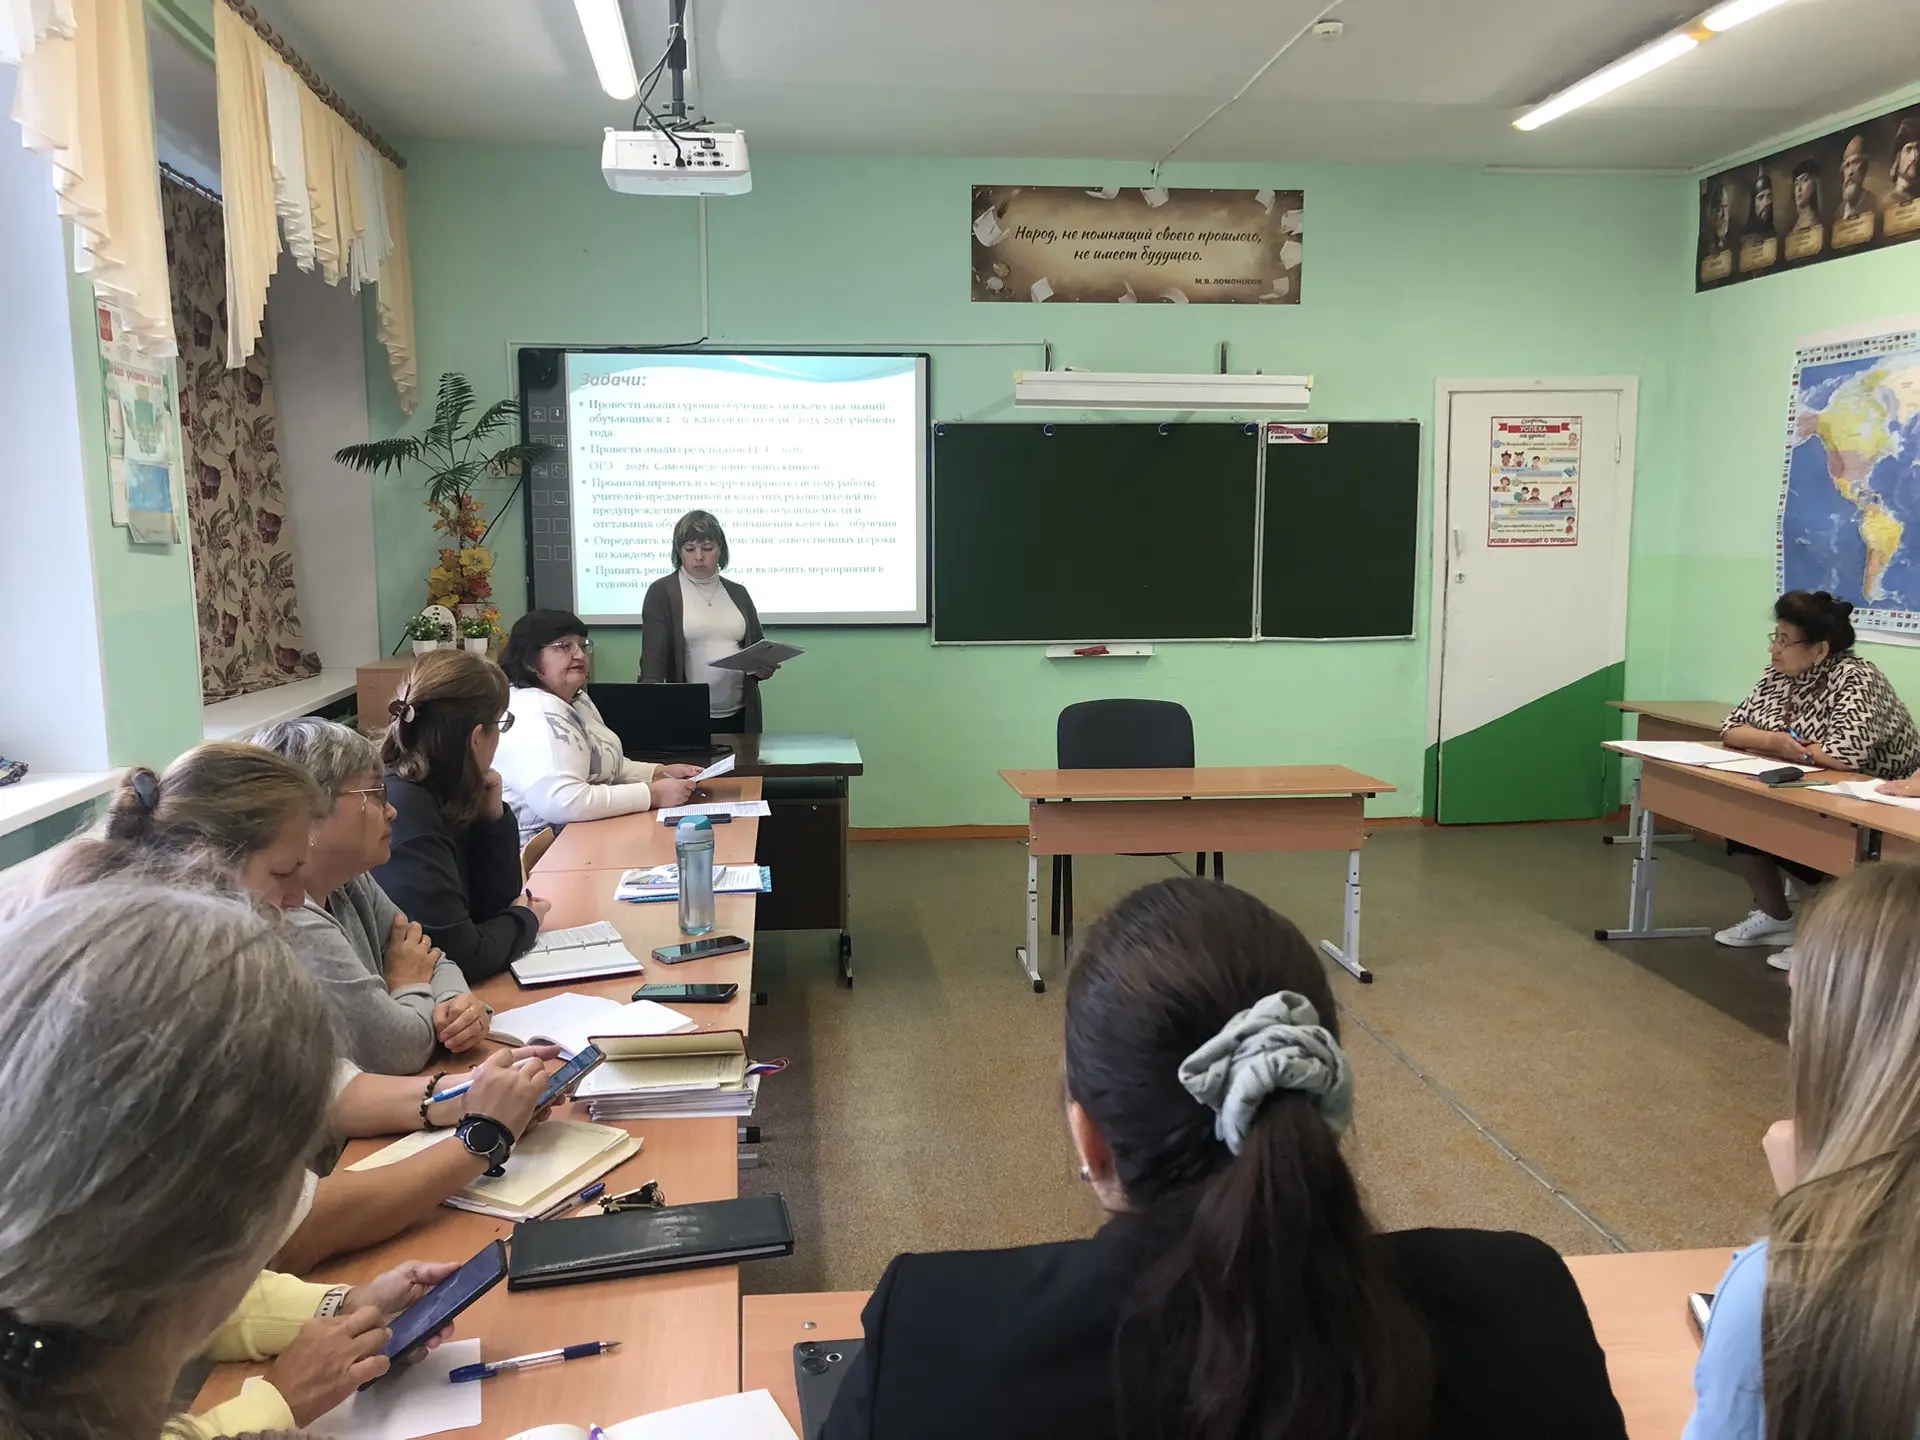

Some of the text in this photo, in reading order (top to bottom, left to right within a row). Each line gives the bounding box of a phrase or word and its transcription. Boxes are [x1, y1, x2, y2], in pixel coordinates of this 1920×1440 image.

[1015, 225, 1261, 246] Народ, не помнящий своего прошлого,
[1074, 245, 1202, 266] не имеет будущего.
[579, 372, 647, 386] Задачи:
[589, 400, 641, 411] Провести
[589, 413, 662, 425] обучающихся
[590, 444, 642, 455] Провести
[592, 478, 694, 489] Проанализировать
[594, 536, 659, 547] Определить
[595, 551, 608, 559] по
[610, 551, 657, 561] каждому
[595, 565, 642, 577] Принять
[596, 579, 640, 589] годовой
